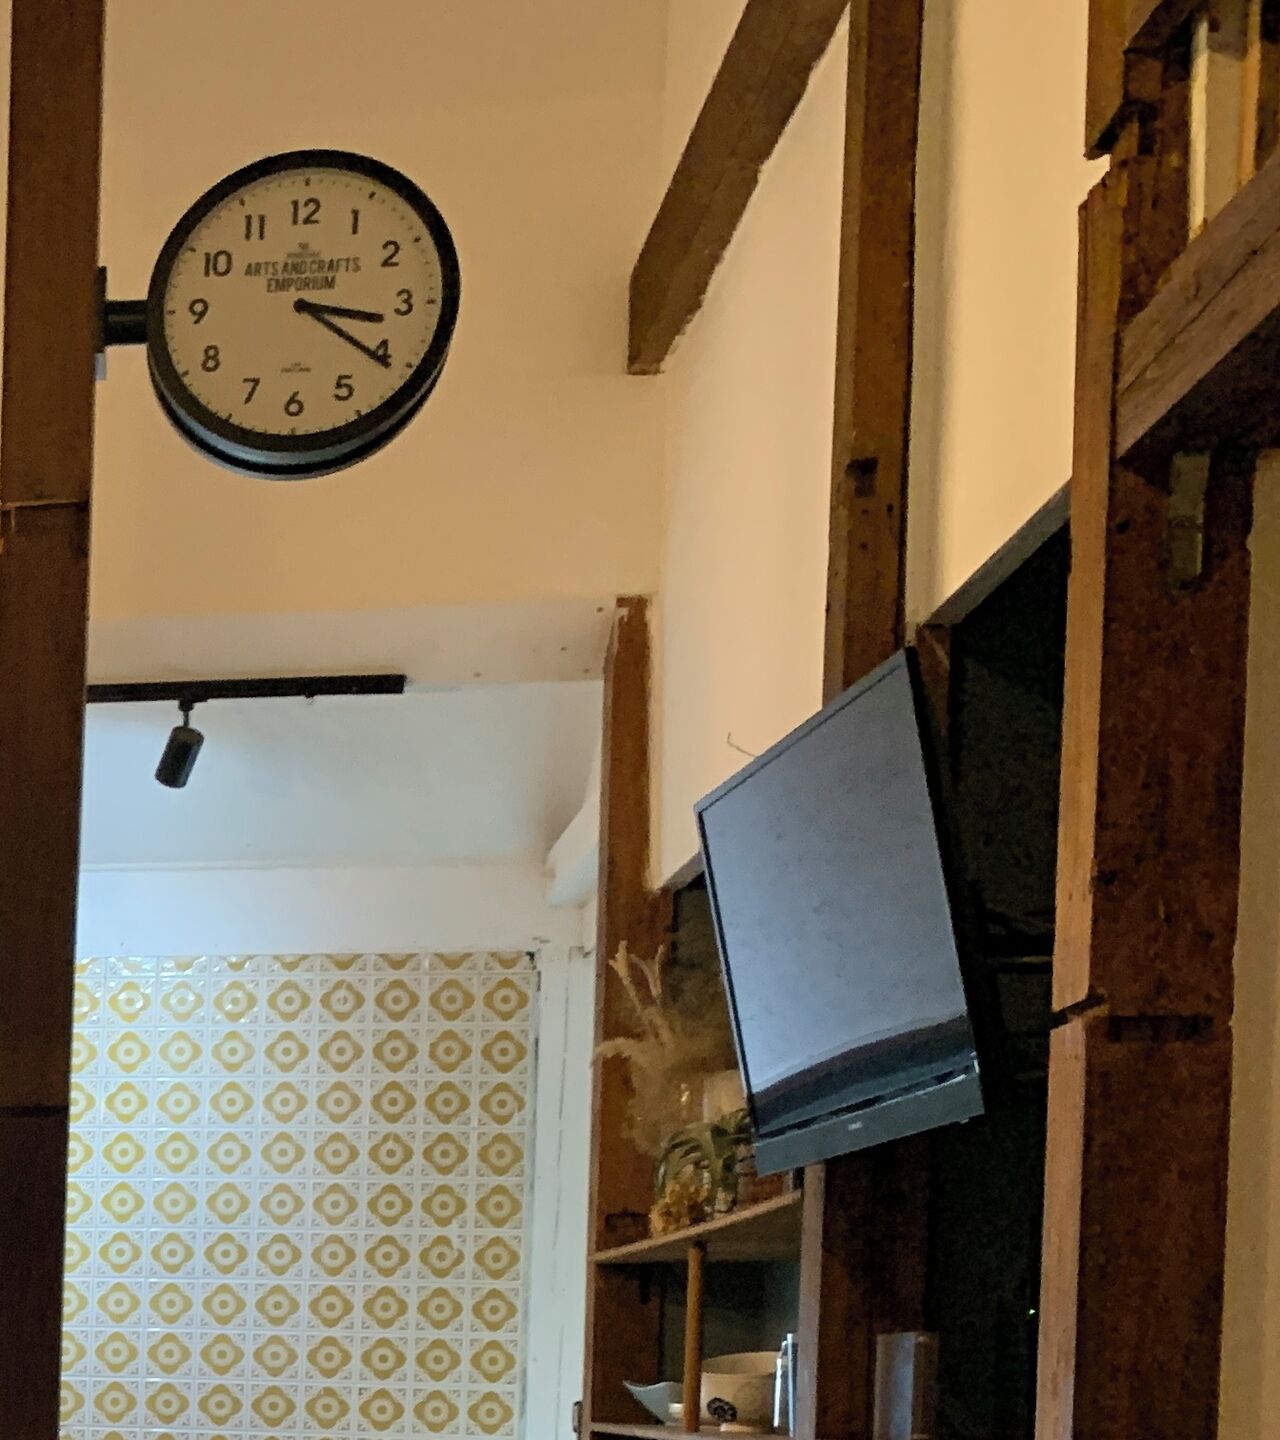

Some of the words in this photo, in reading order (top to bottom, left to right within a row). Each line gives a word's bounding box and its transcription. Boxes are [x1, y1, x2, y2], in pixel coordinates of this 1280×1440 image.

[291, 198, 320, 226] 12
[351, 208, 359, 235] 1
[244, 214, 265, 240] 11
[204, 250, 232, 277] 10
[244, 261, 279, 276] ARTS
[281, 260, 307, 276] AND
[309, 256, 361, 275] CRAFTS
[381, 240, 400, 267] 2
[266, 275, 336, 293] EMPORIUM
[189, 298, 208, 325] 9
[394, 289, 413, 316] 3
[201, 345, 220, 372] 8
[242, 377, 260, 404] 7
[334, 374, 354, 401] 5
[284, 391, 304, 417] 6
